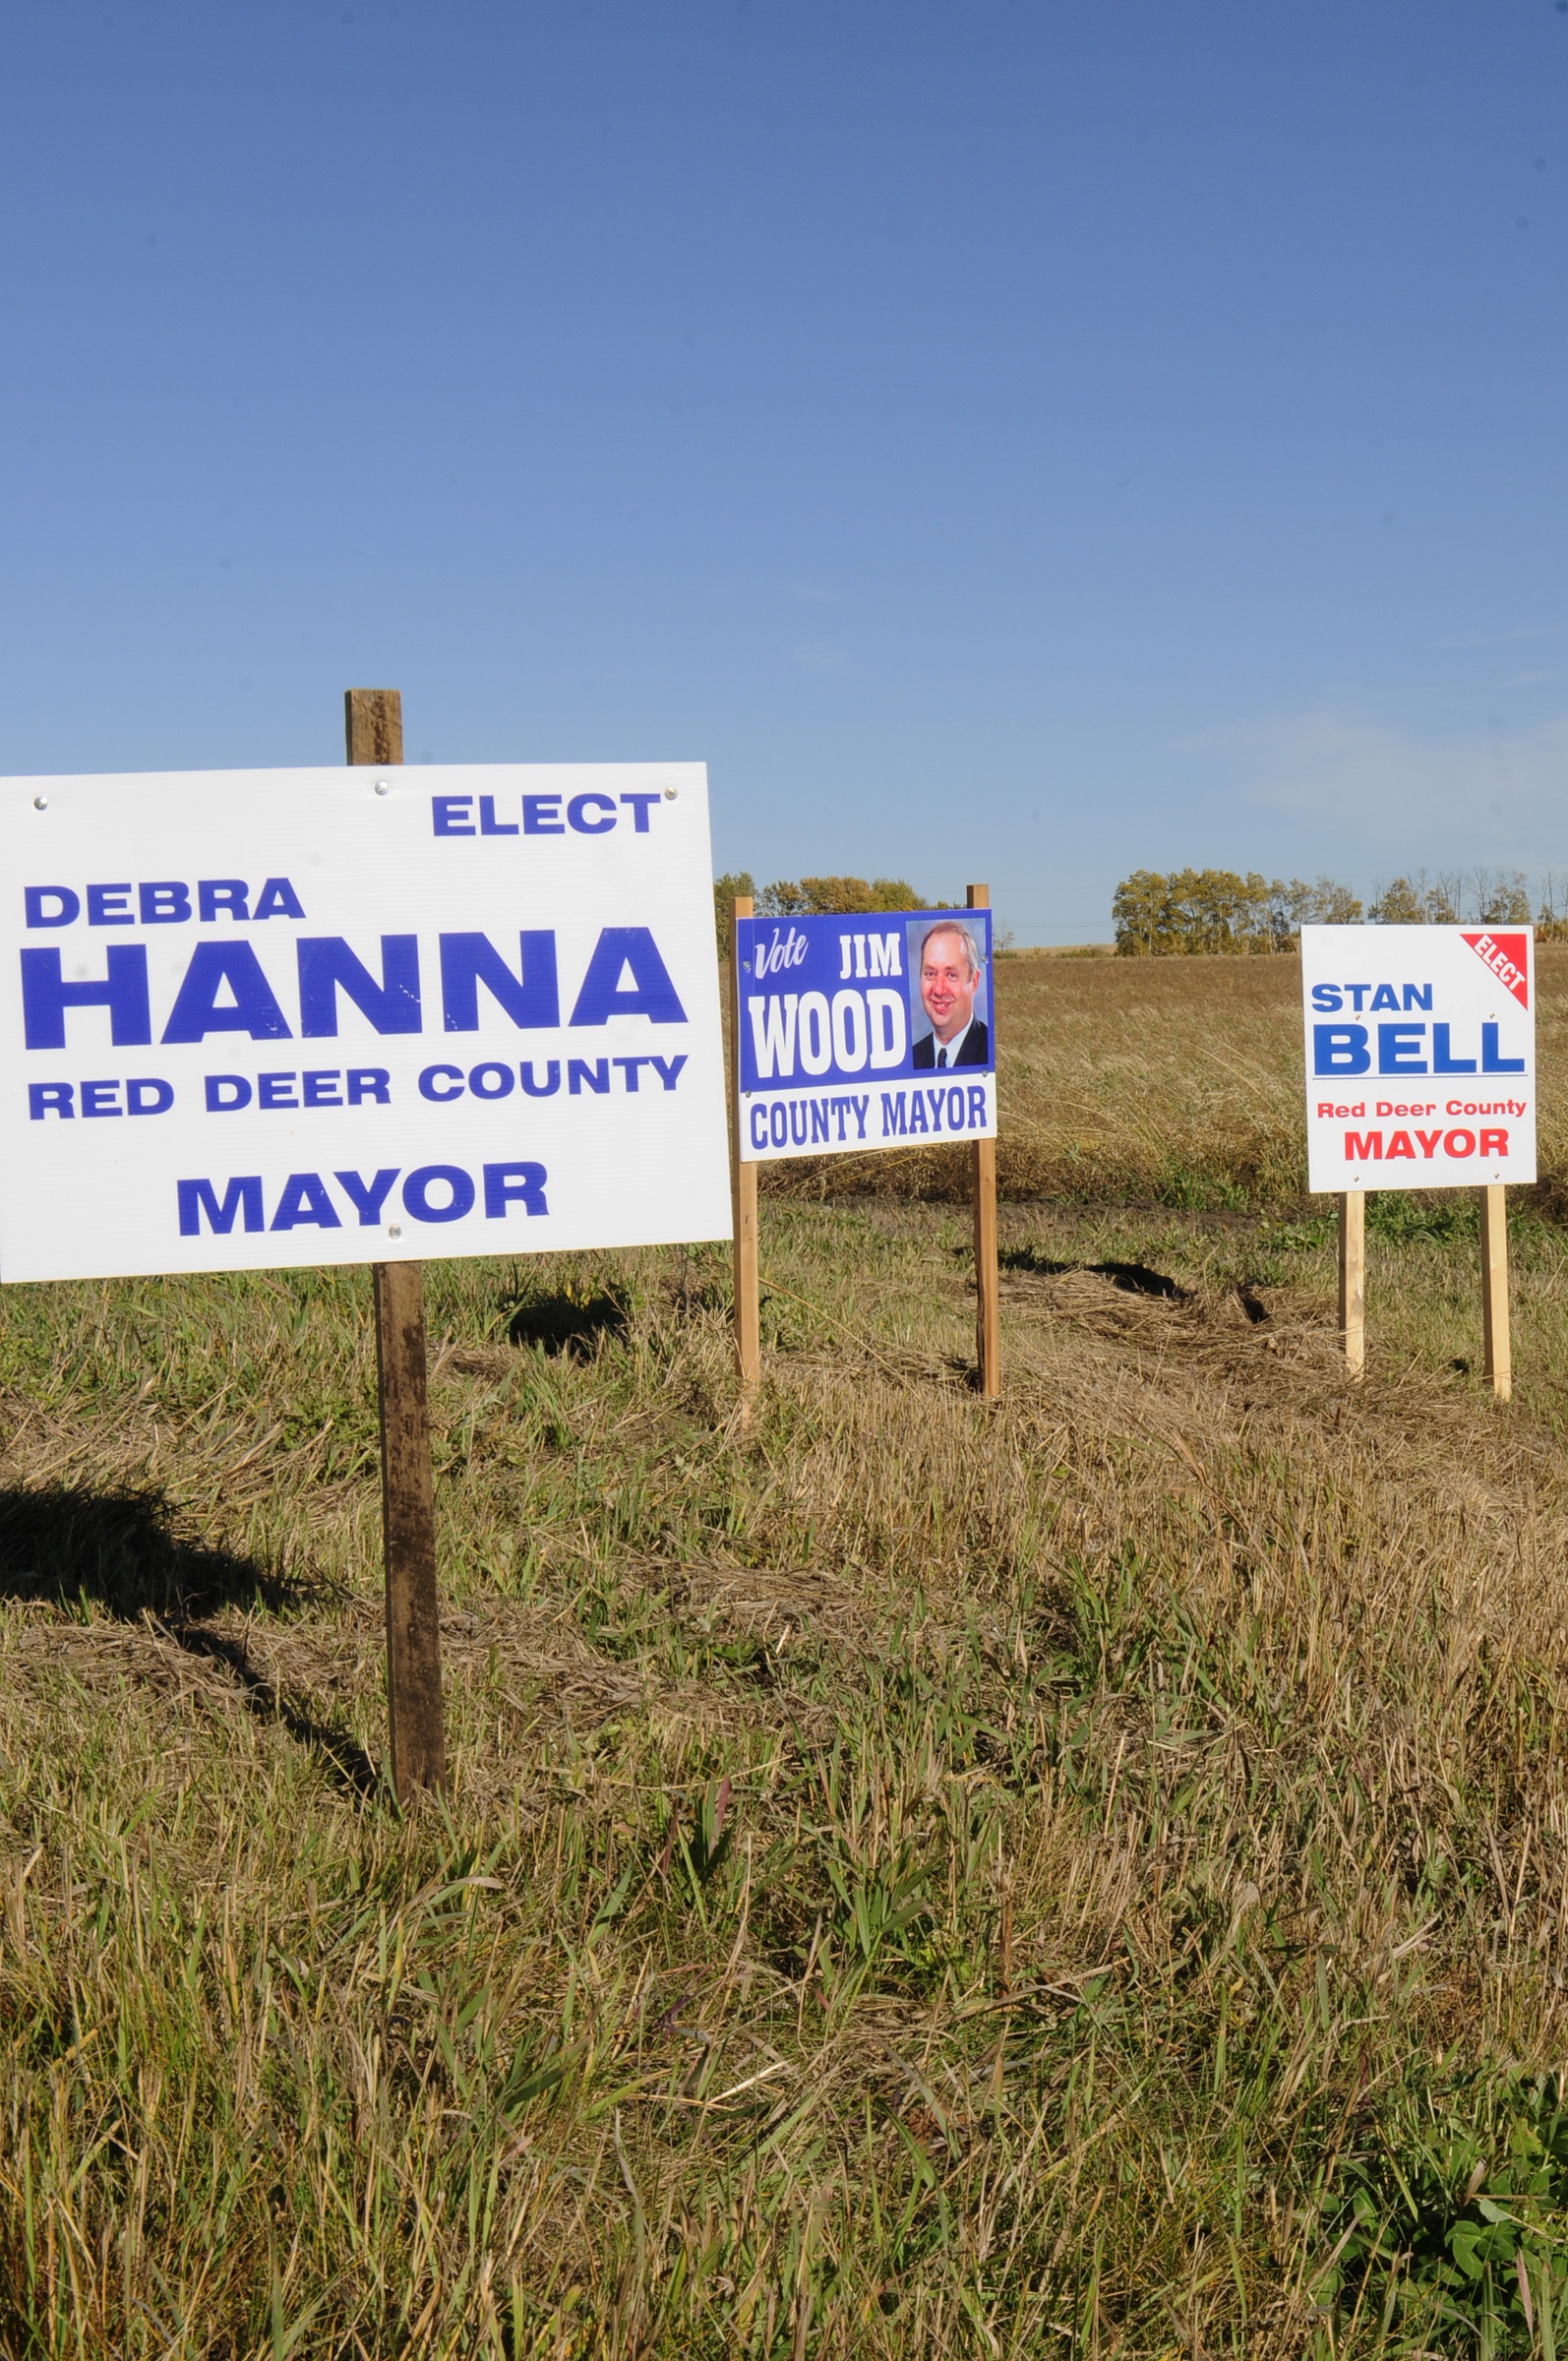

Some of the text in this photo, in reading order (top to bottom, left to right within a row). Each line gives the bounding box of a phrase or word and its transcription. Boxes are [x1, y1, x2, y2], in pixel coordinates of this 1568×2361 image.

[432, 793, 661, 836] ELECT
[24, 878, 306, 929] DEBRA
[754, 927, 902, 979] Vote JIM
[1474, 935, 1526, 991] ELECT
[20, 927, 689, 1050] HANNA
[1311, 984, 1432, 1012] STAN
[749, 989, 906, 1078] WOOD
[1313, 1022, 1525, 1075] BELL
[28, 1055, 690, 1120] RED DEER COUNTY
[1317, 1099, 1527, 1118] Red Deer County
[751, 1085, 987, 1150] COUNTY MAYOR
[1345, 1128, 1509, 1160] MAYOR
[177, 1161, 549, 1237] MAYOR
